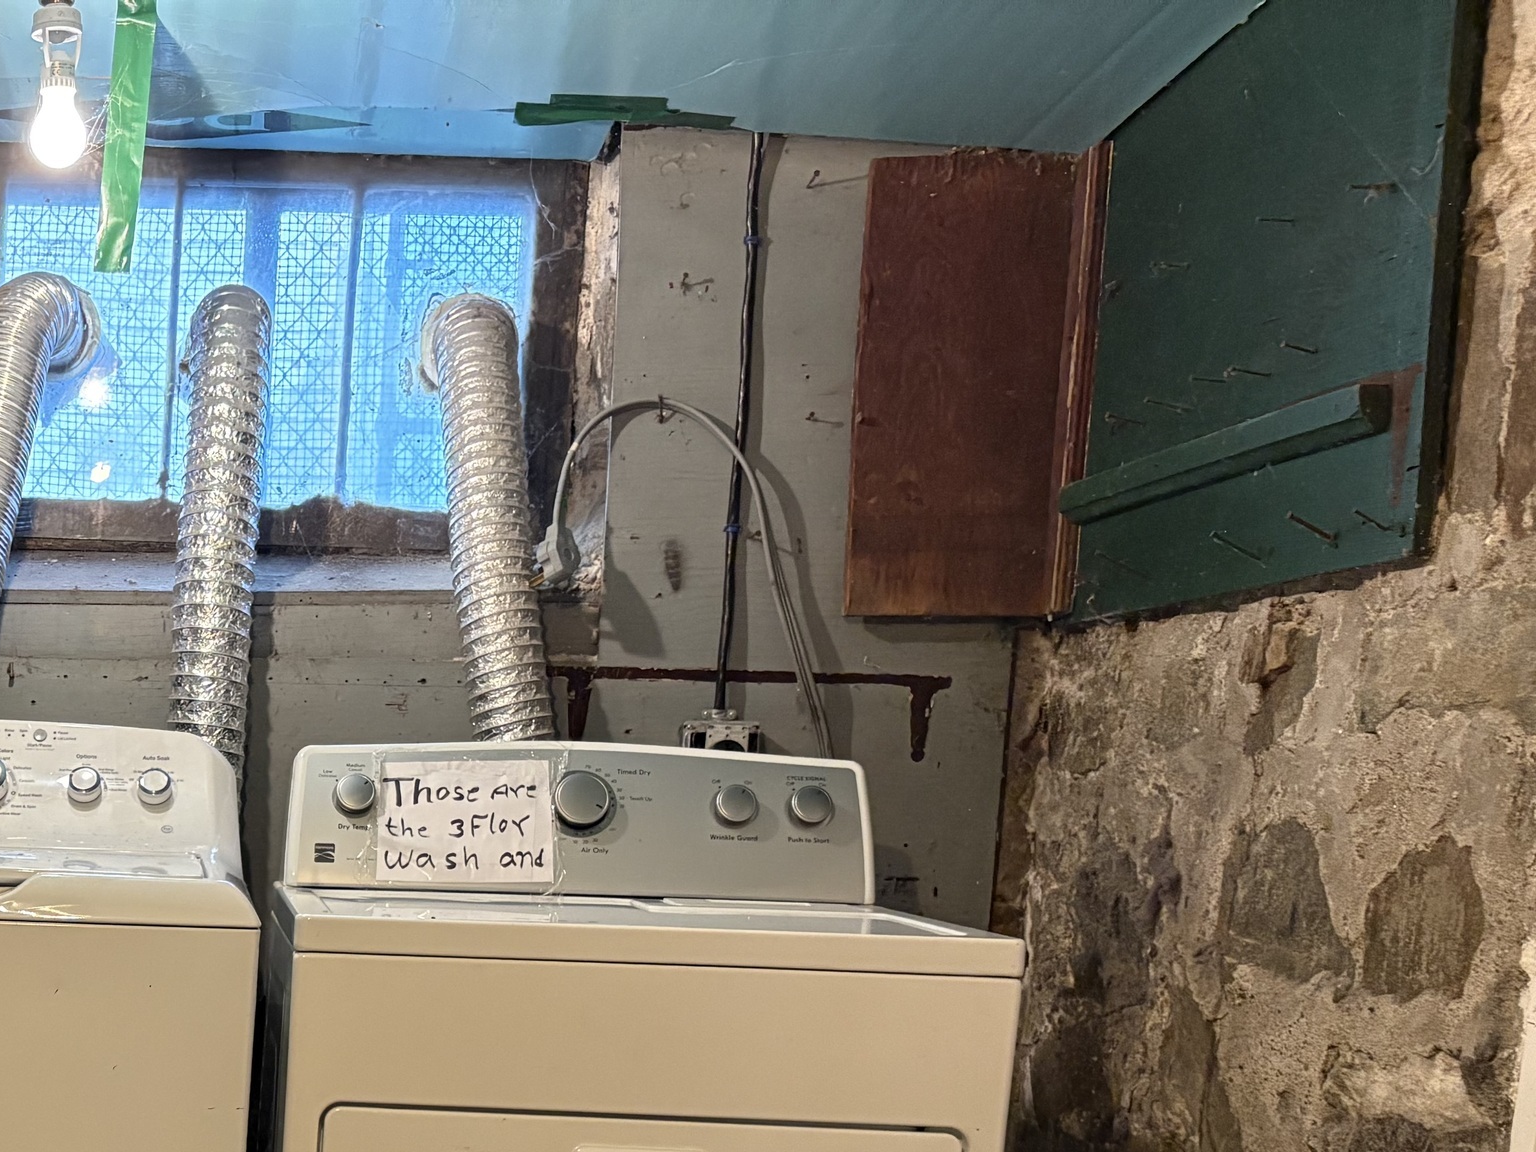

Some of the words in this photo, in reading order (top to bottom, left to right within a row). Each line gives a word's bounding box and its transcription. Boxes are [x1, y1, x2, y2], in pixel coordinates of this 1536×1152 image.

[382, 777, 480, 807] Those
[337, 823, 351, 831] Dry
[385, 816, 430, 838] the
[499, 847, 545, 869] and
